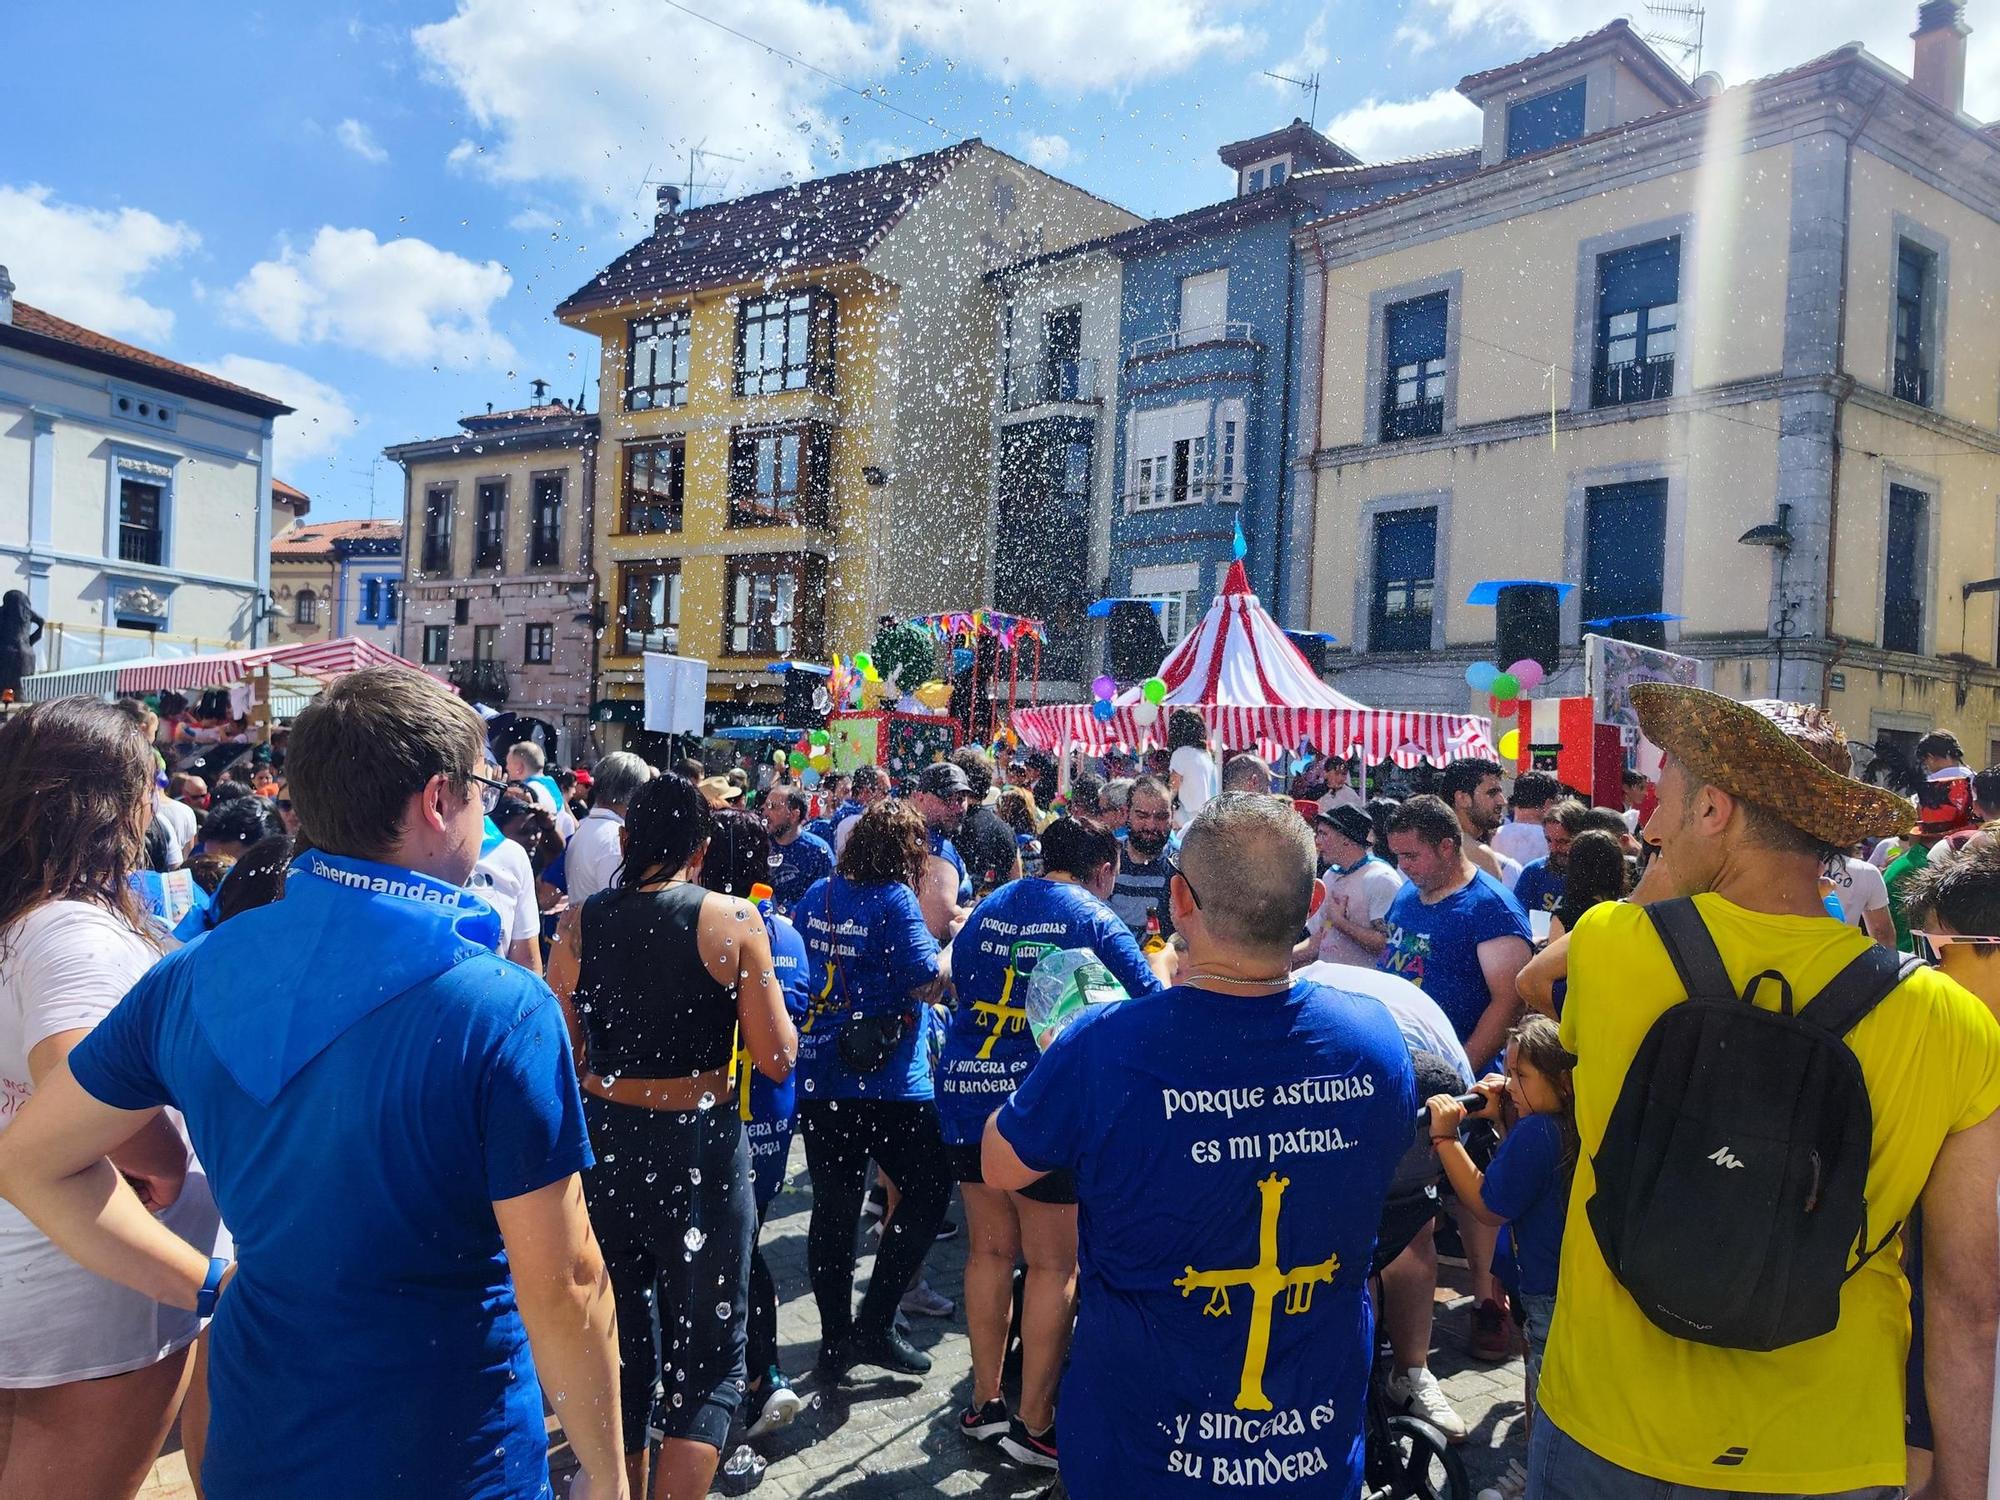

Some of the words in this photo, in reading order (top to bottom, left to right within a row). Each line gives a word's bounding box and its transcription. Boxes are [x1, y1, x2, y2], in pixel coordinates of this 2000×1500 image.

[979, 916, 1018, 937] PORQUE
[1019, 922, 1068, 937] ASTURIAS
[980, 940, 993, 953] ES
[772, 955, 797, 969] URIAS
[956, 1060, 1006, 1074] SINCERA
[943, 1079, 956, 1093] SU
[959, 1077, 1017, 1094] BANDERA
[1161, 1086, 1266, 1121] PORQUE
[1272, 1073, 1376, 1106] ASTURIAS
[1191, 1139, 1222, 1164] ES
[1228, 1133, 1262, 1161] MI
[1199, 1408, 1306, 1444] SINCERA
[1167, 1449, 1203, 1479] SU
[1211, 1445, 1329, 1487] BANDERA
